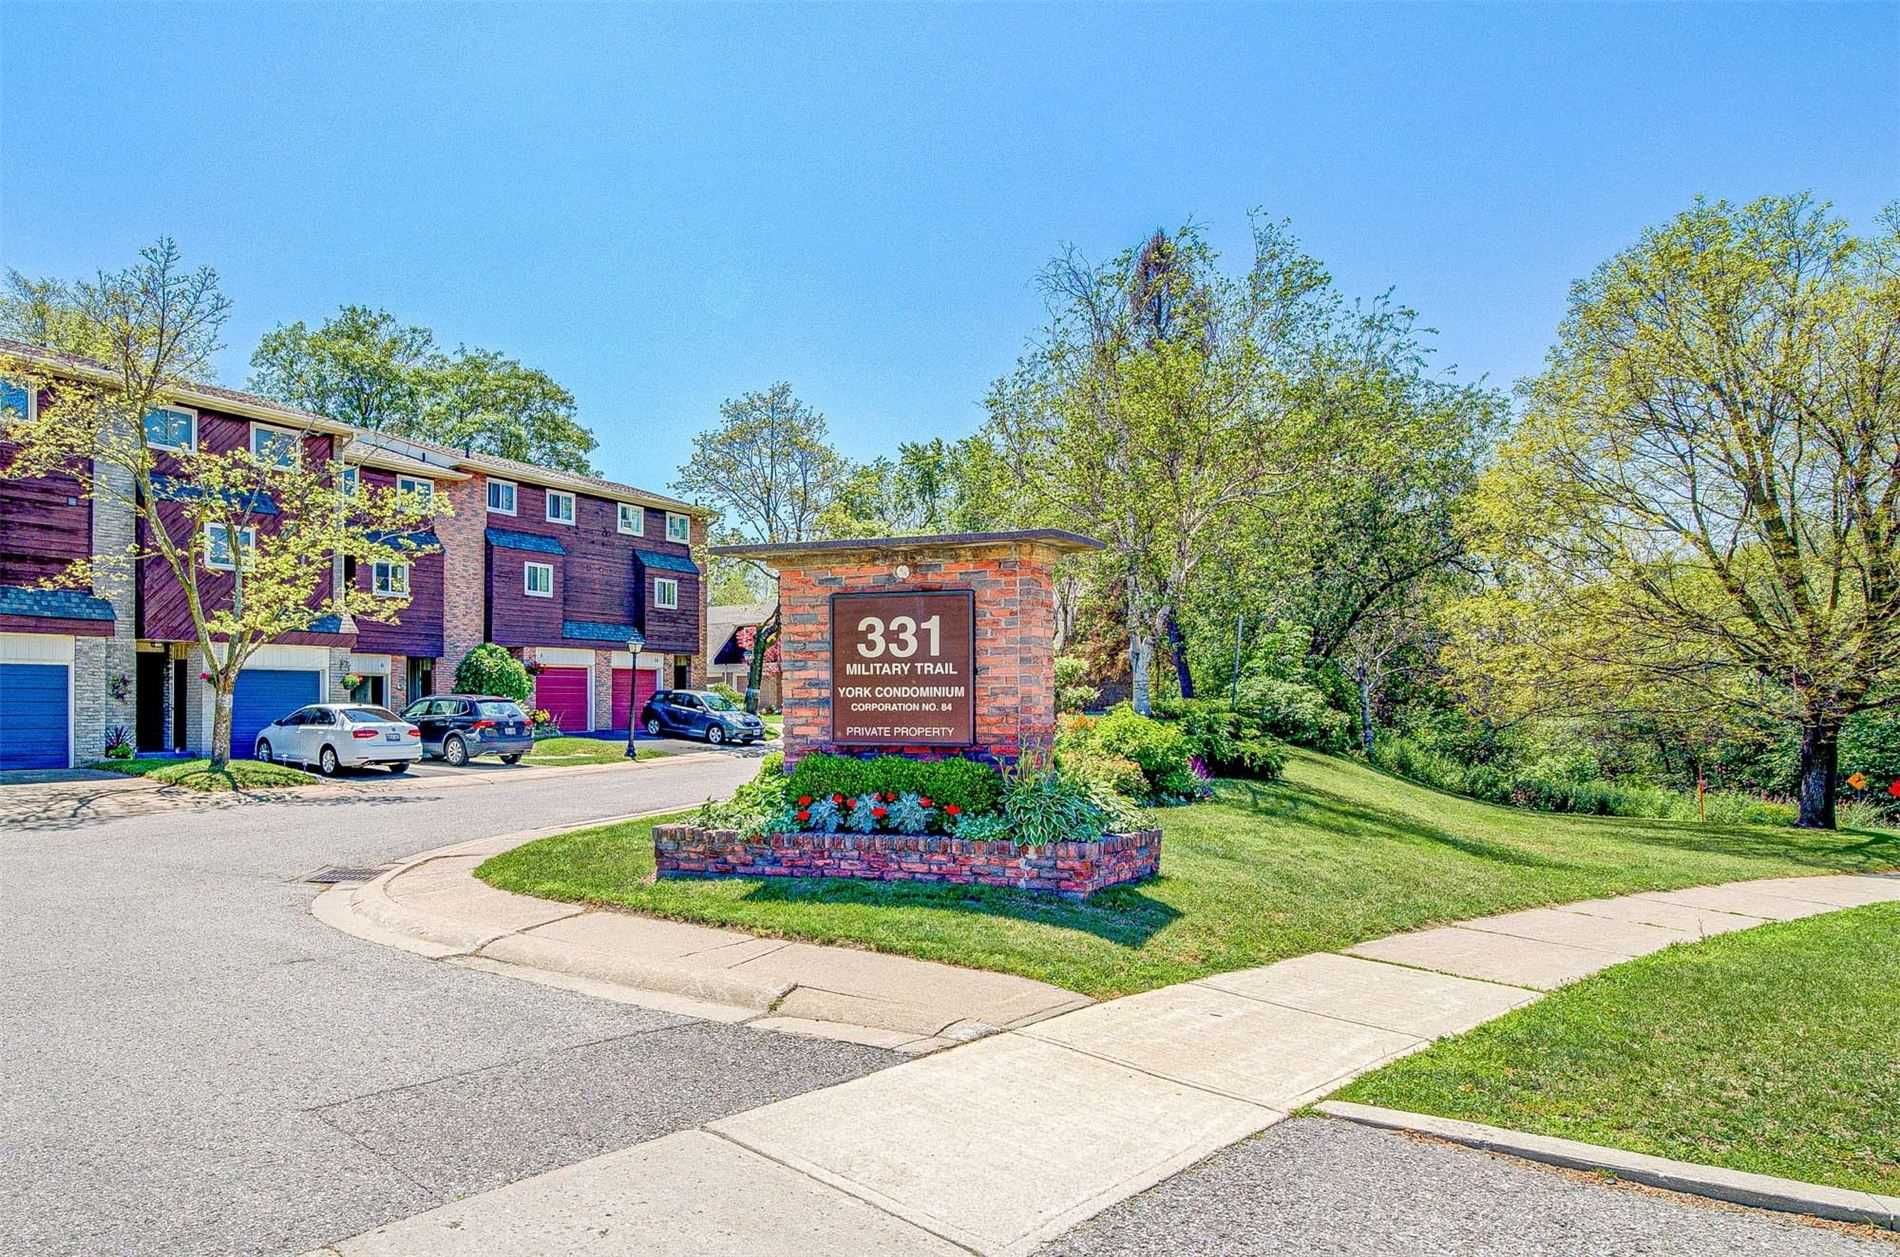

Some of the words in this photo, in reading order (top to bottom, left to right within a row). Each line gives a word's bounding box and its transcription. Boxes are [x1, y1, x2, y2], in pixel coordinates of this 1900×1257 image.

[857, 615, 940, 658] 331
[846, 663, 910, 675] MILITARY
[915, 662, 958, 674] TRAIL
[838, 687, 871, 698] YORK
[875, 686, 965, 698] CONDOMINIUM
[851, 703, 919, 712] CORPORATION
[922, 703, 939, 711] NO.
[941, 703, 952, 712] 84
[846, 727, 891, 736] PRIVATE
[893, 727, 954, 737] PROPERTY
